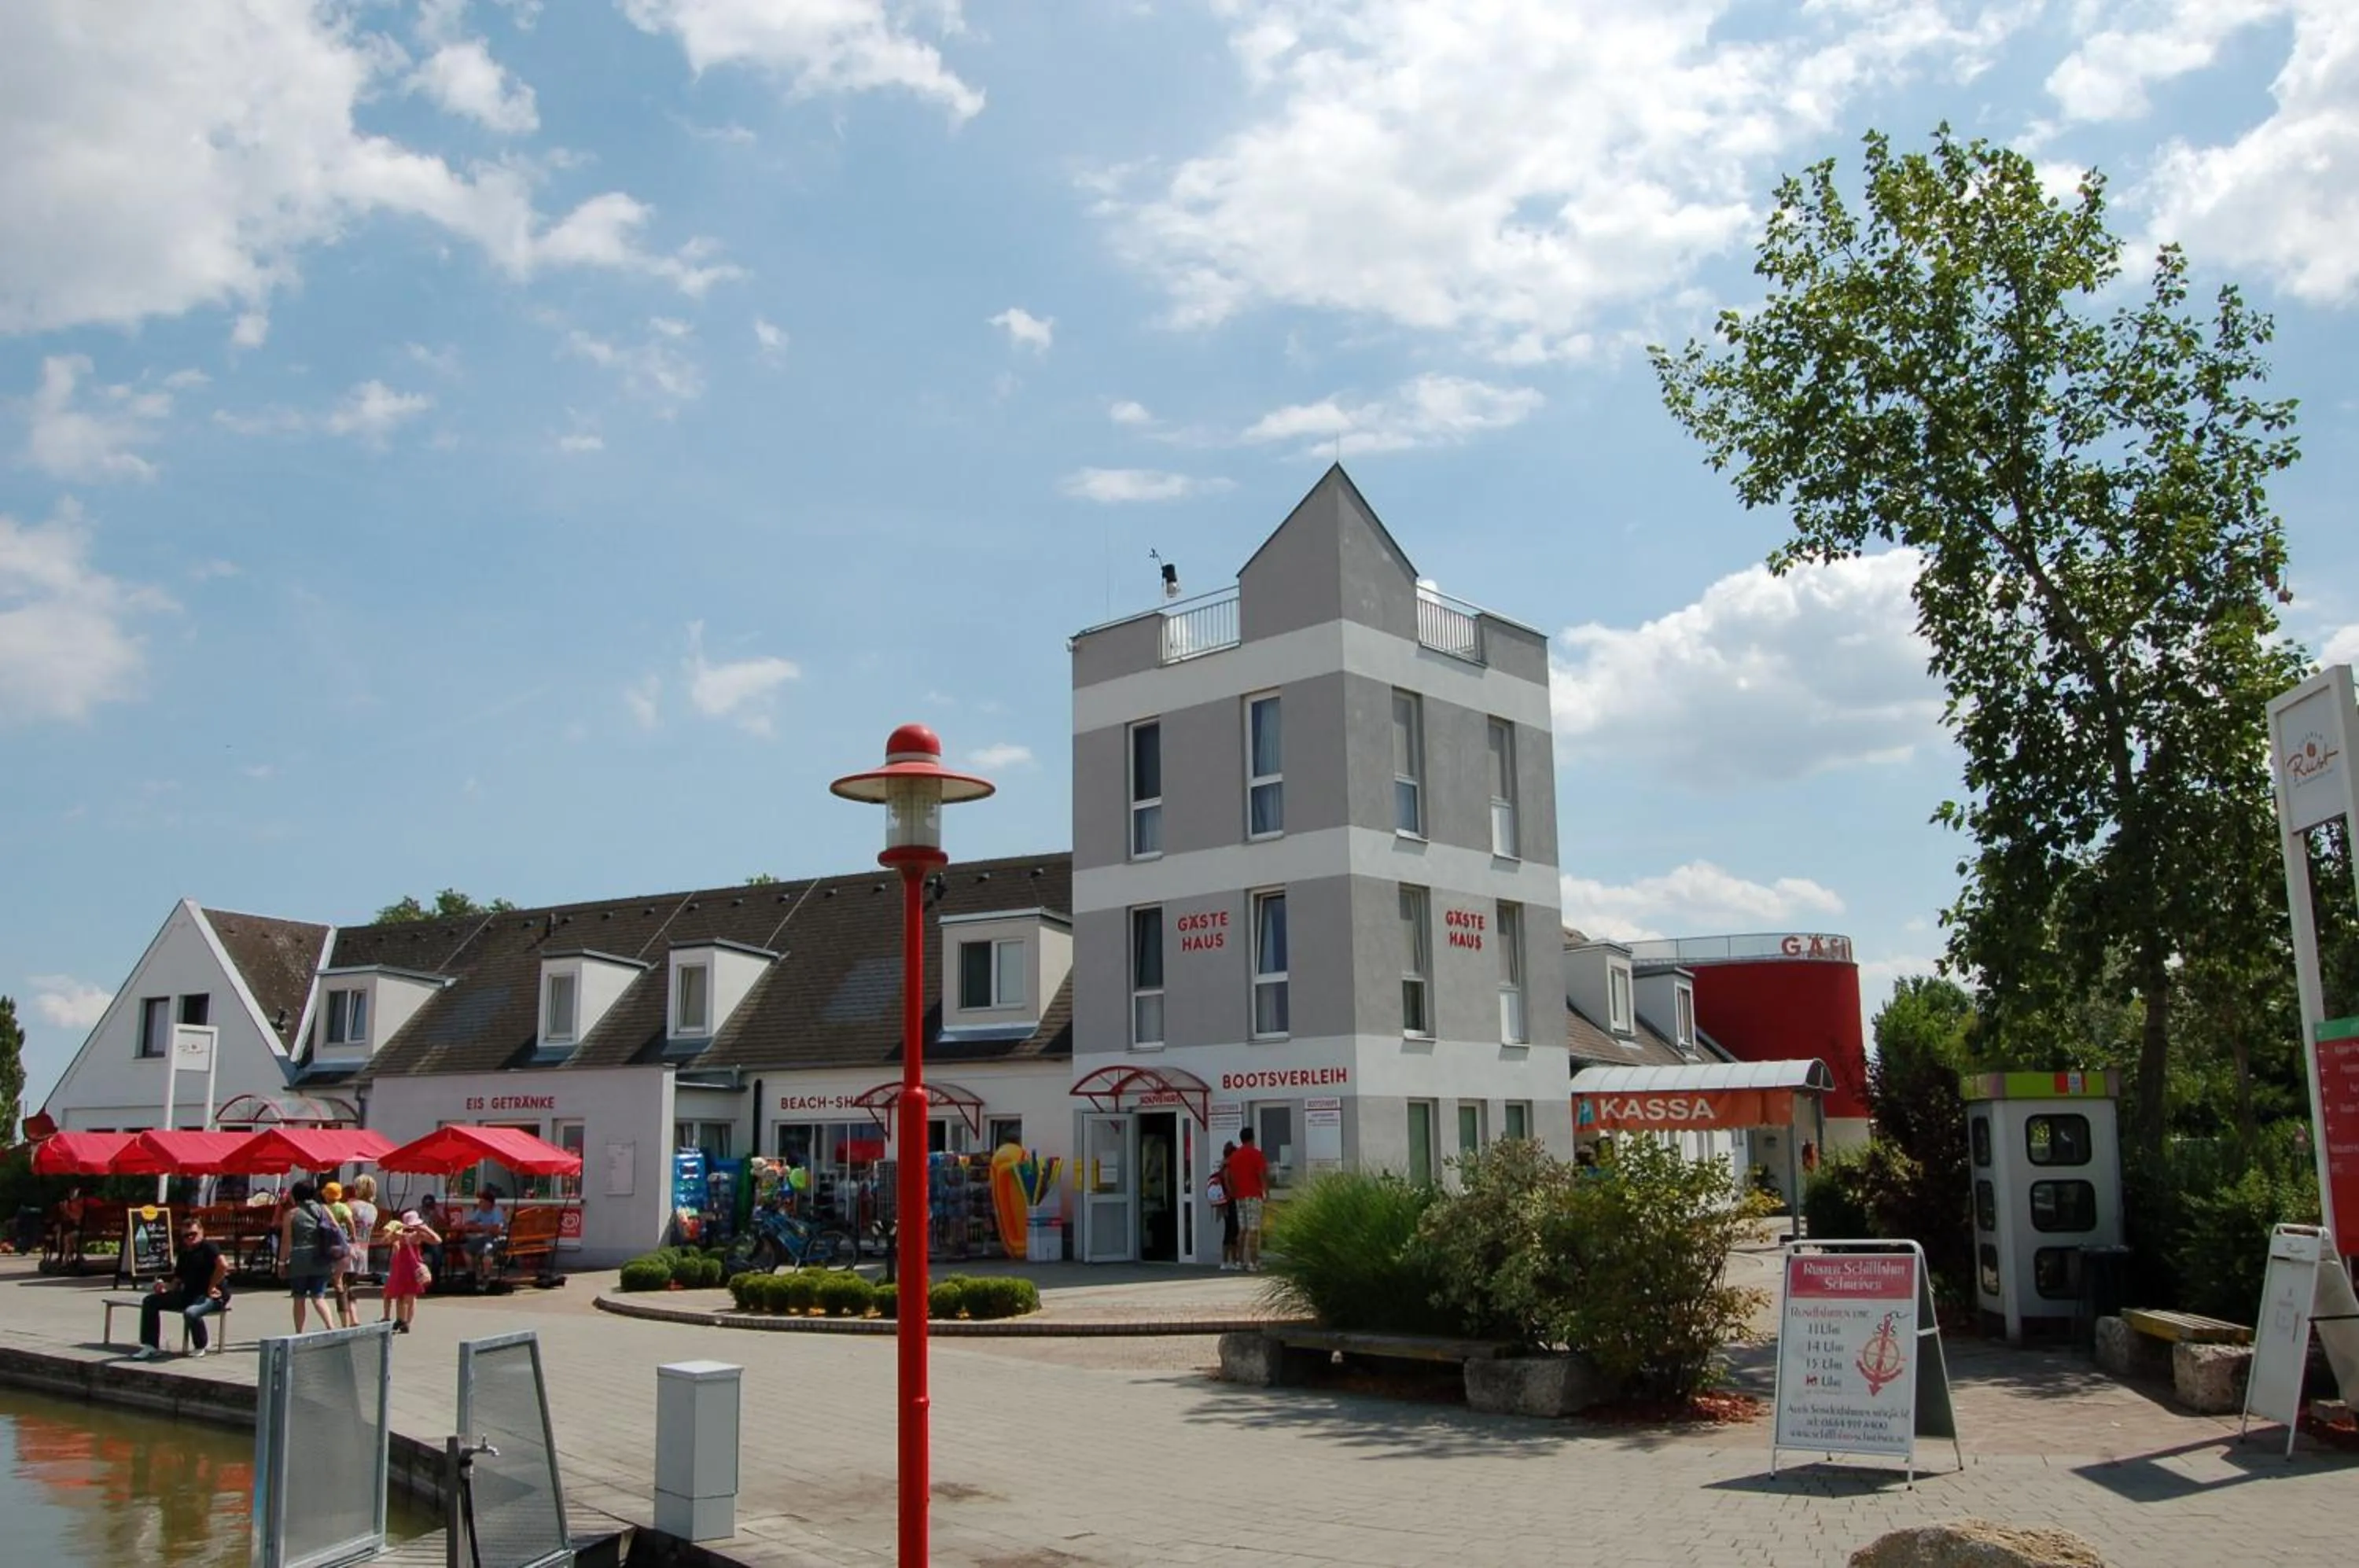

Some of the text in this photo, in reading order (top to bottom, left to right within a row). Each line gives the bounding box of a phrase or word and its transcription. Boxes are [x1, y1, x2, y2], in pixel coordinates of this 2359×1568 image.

[1177, 911, 1228, 932] GÄSTE
[1445, 909, 1485, 930] GÄSTE
[1182, 933, 1224, 951] HAUS
[1449, 931, 1483, 951] HAUS
[1222, 1067, 1347, 1089] BOOTSVERLEIH
[466, 1095, 555, 1110] EIS GETRÄNKE
[780, 1095, 874, 1110] BEACH-SHP
[1599, 1097, 1716, 1121] KASSA
